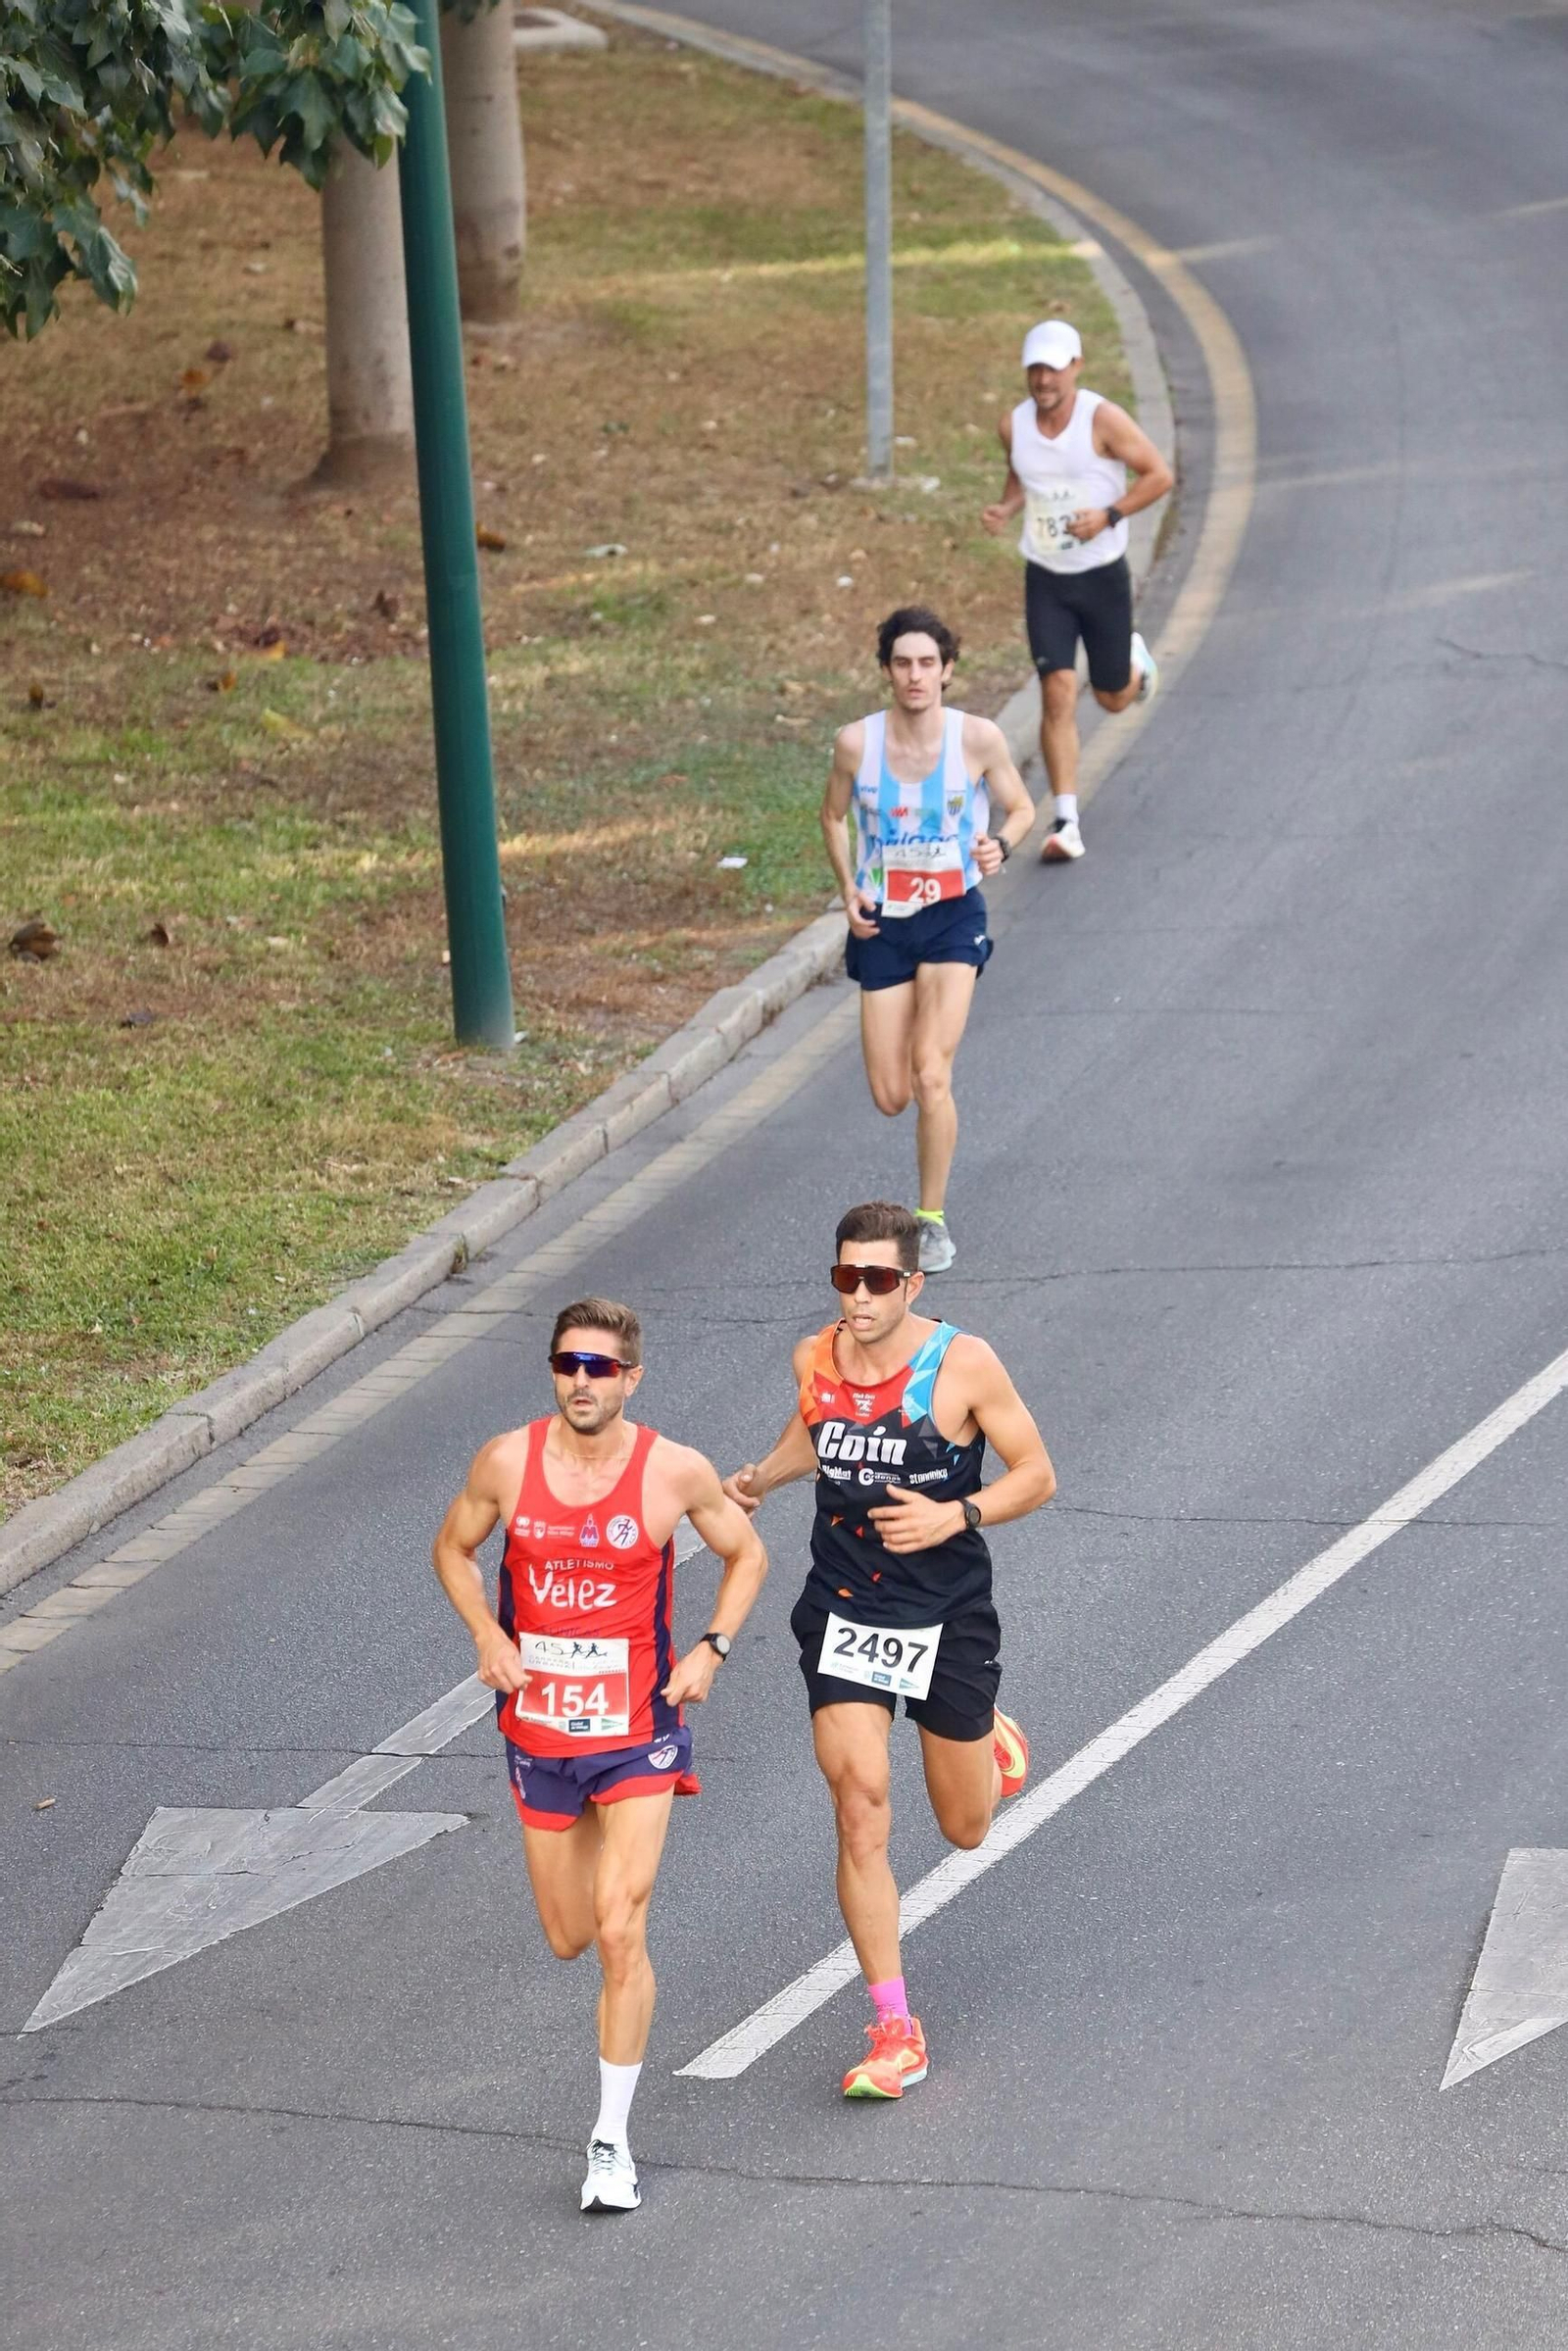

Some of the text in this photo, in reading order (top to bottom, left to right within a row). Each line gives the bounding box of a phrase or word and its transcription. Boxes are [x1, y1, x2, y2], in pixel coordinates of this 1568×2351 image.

[907, 877, 942, 904] 29
[544, 1558, 614, 1572] ATLETISMO
[528, 1563, 618, 1612] Vélez
[833, 1627, 929, 1673] 2497
[540, 1682, 610, 1718] 154
